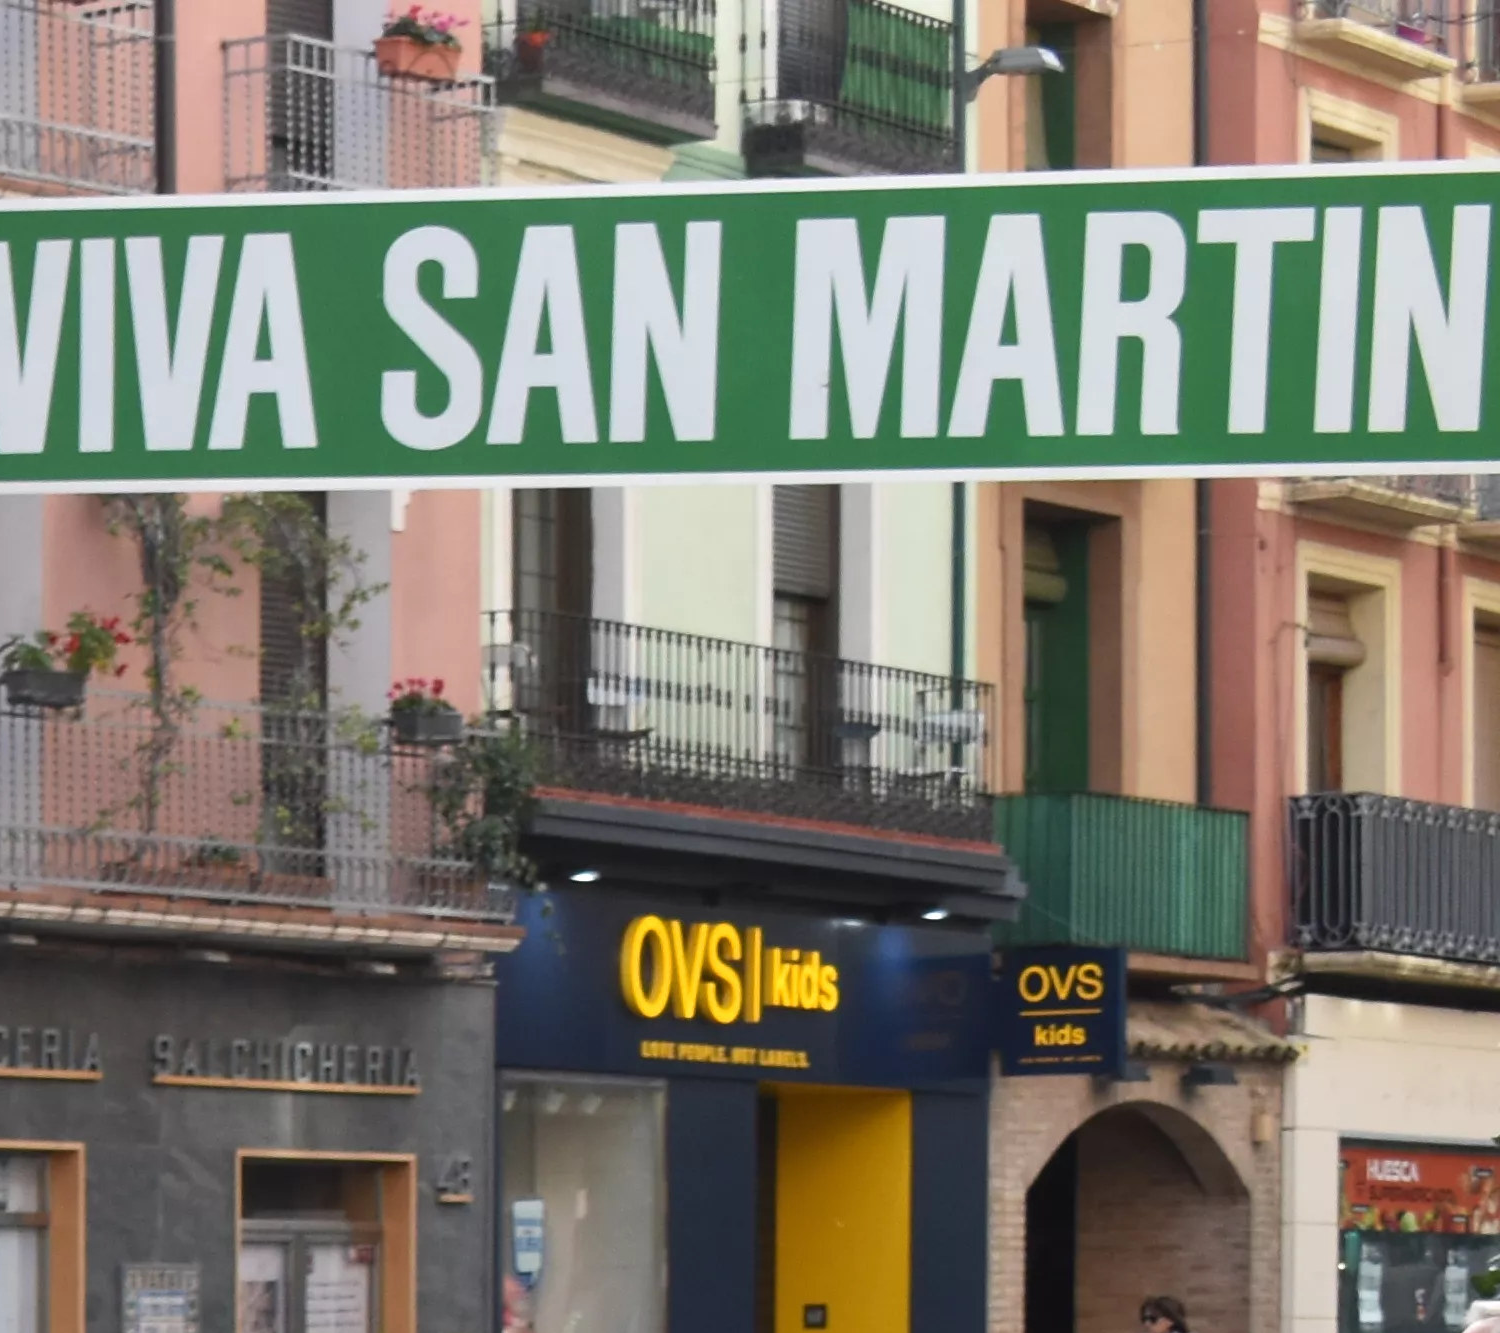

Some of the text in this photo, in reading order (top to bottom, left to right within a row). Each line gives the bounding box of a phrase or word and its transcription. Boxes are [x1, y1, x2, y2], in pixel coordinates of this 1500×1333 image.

[380, 222, 722, 451] SAN
[789, 204, 1492, 440] MARTIN
[620, 914, 840, 1025] OVS kids
[1018, 963, 1104, 1003] OVS
[1033, 1023, 1087, 1047] kids
[1366, 1158, 1421, 1182] HUESCA
